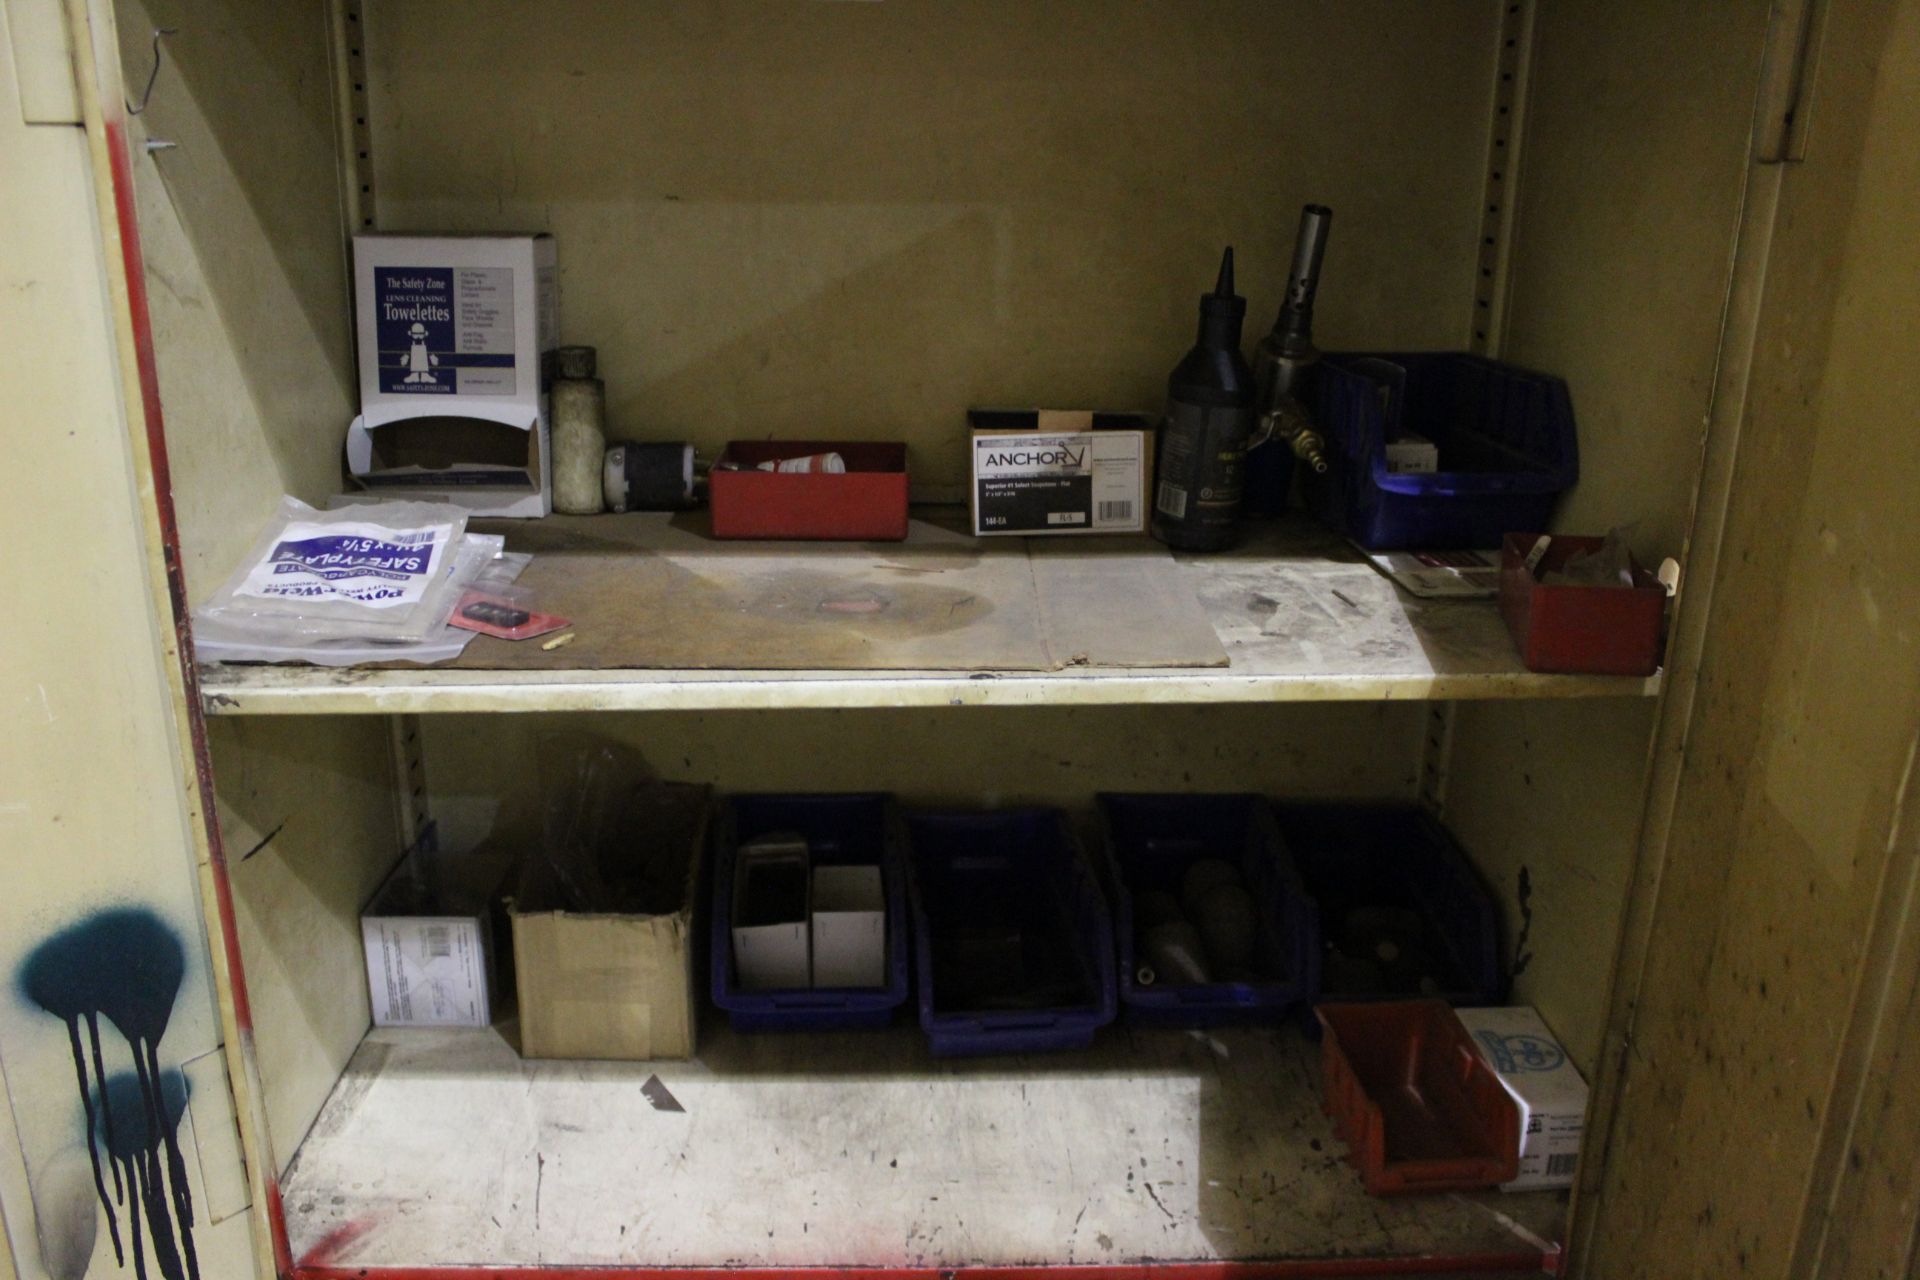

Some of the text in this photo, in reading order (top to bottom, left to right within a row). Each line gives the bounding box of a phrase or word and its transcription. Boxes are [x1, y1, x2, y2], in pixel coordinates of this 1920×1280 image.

[387, 277, 446, 292] The Safety Zone
[385, 294, 447, 303] LENS CLEANING
[383, 302, 450, 321] Towelettes
[985, 452, 1067, 467] ANCHOR
[278, 551, 421, 571] SAFETYPLATE
[278, 563, 408, 581] POLYCARBOATE
